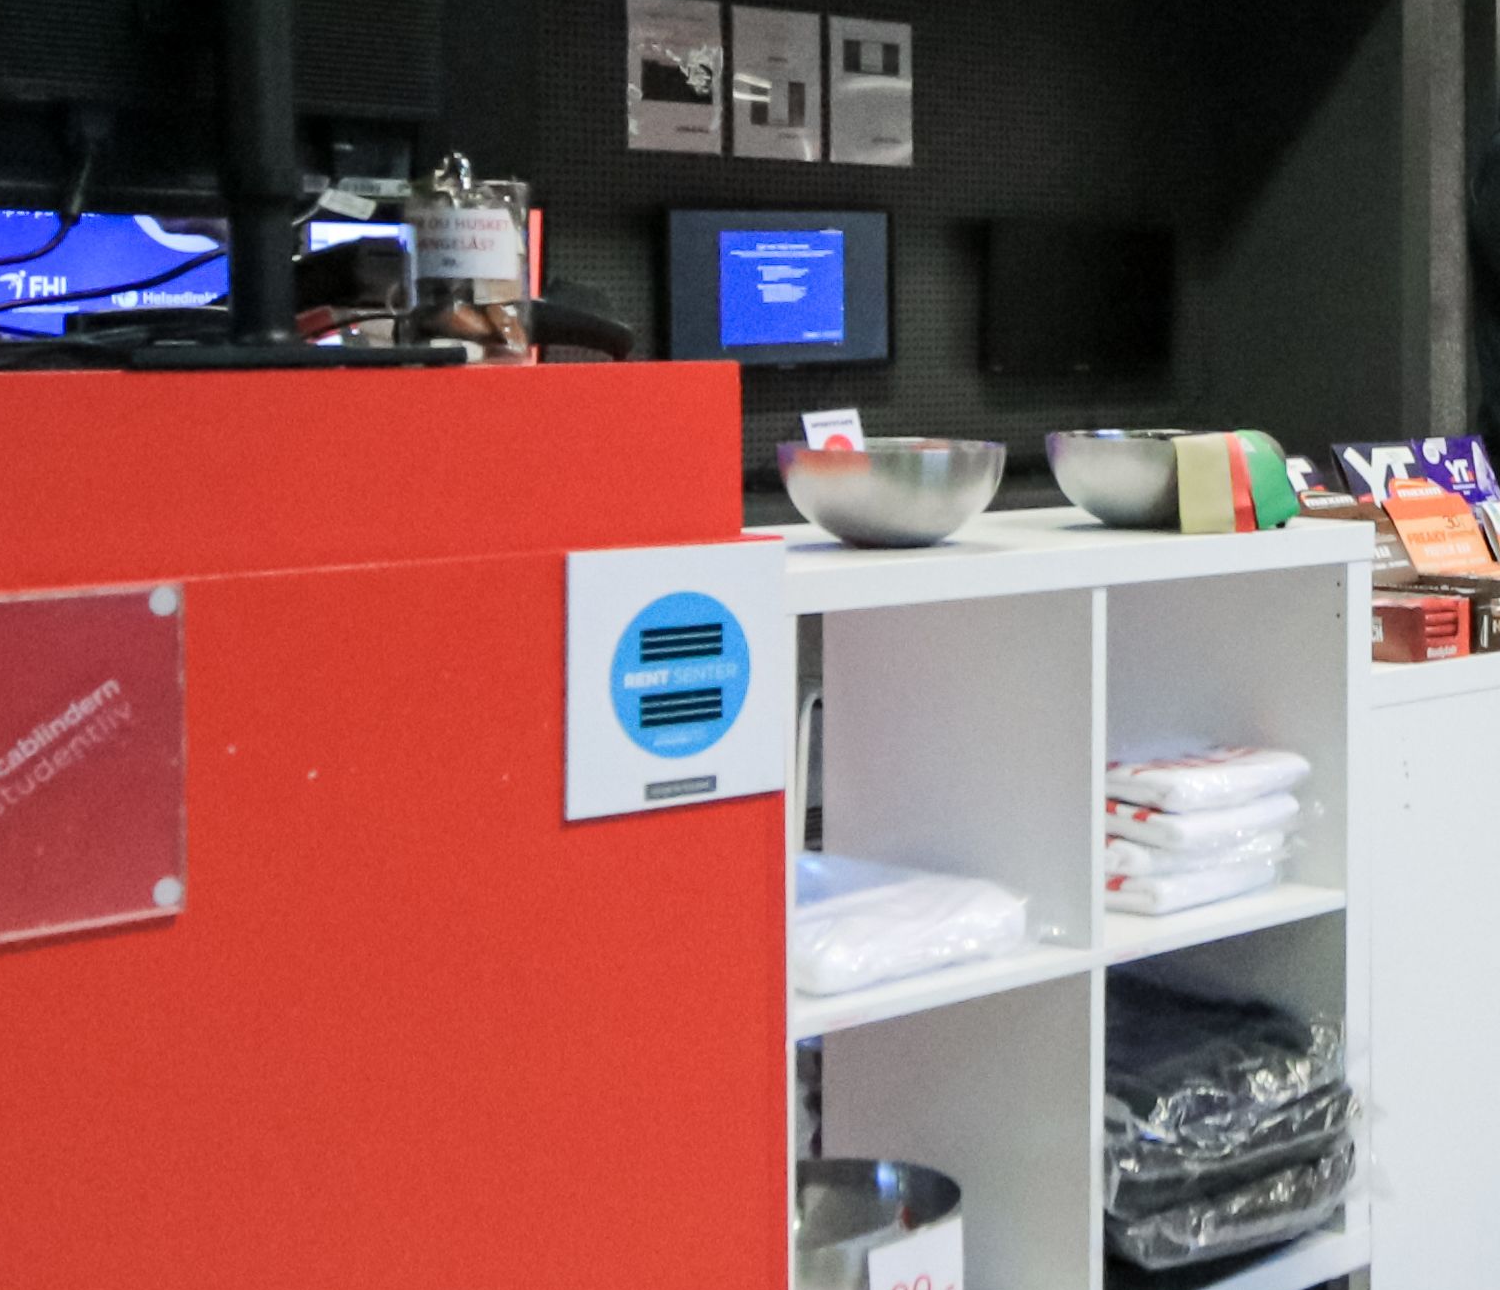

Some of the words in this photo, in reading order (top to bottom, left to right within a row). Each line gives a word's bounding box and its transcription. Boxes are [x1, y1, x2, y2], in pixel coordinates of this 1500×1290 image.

[28, 276, 67, 298] FHI
[1343, 446, 1416, 509] YT
[1445, 459, 1471, 483] YT
[624, 669, 669, 689] RENT
